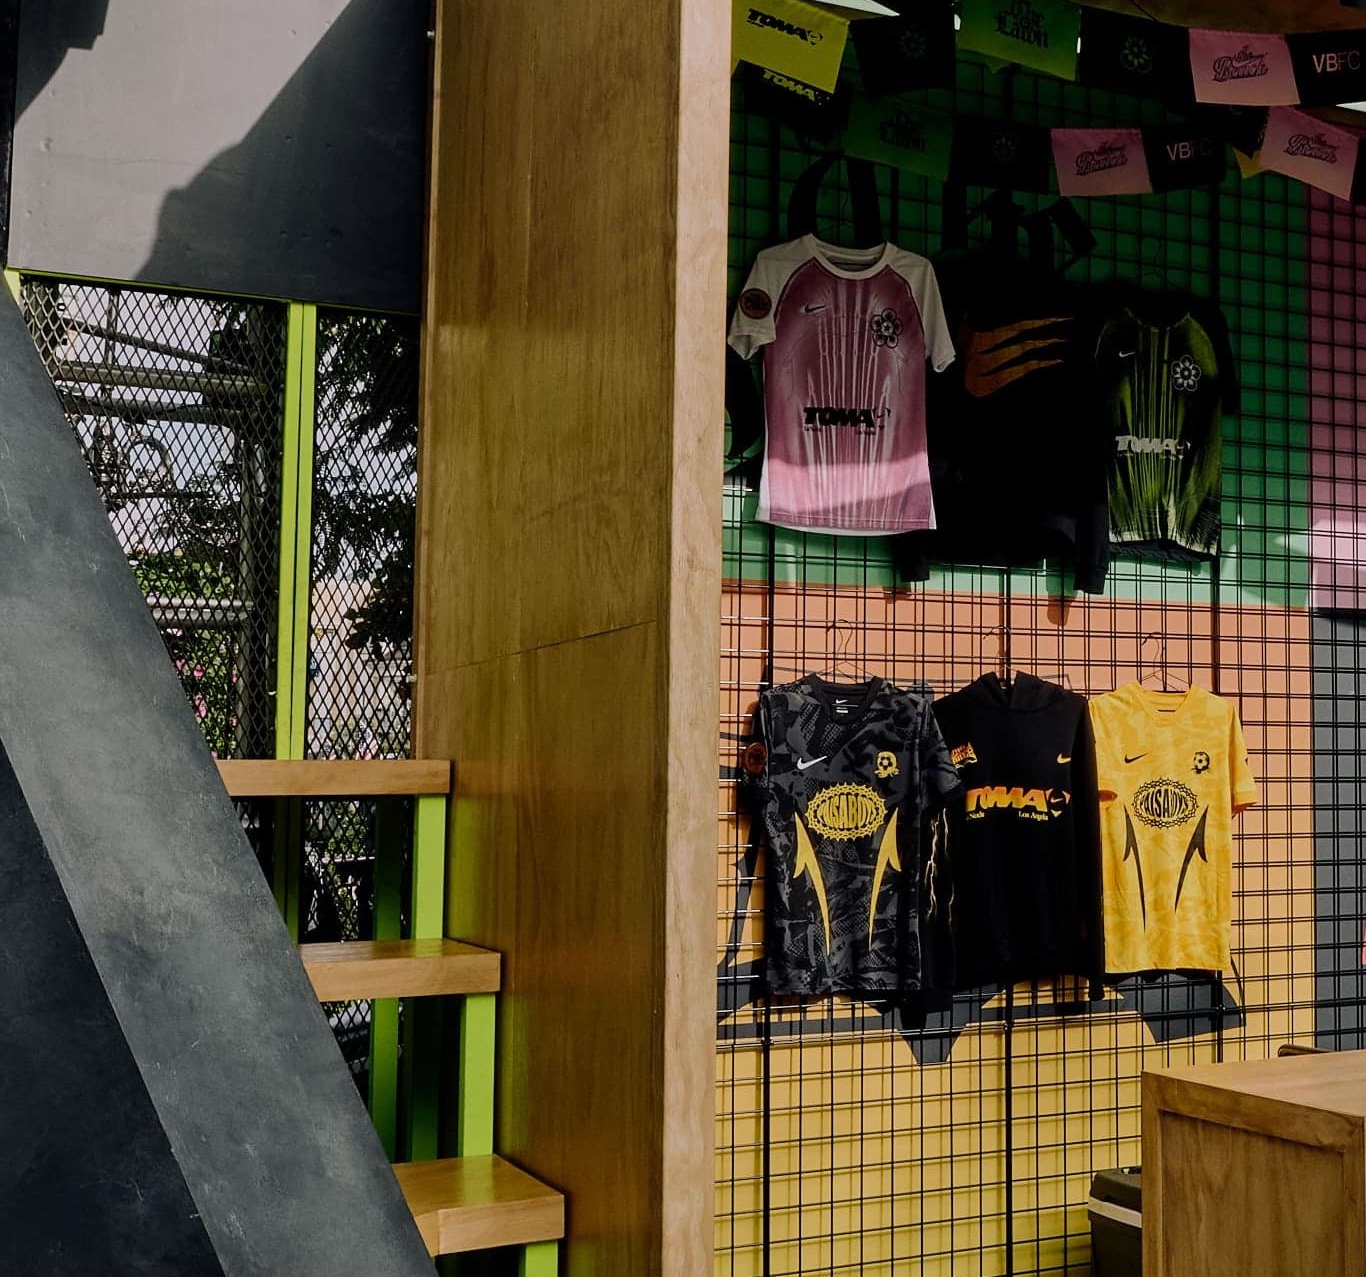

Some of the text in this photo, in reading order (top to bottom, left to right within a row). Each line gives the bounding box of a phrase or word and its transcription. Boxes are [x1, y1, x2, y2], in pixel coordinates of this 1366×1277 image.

[747, 8, 810, 42] TOMA
[1312, 49, 1362, 74] VBFC
[762, 68, 816, 101] TOMA
[803, 407, 875, 428] TOMA
[1114, 434, 1177, 455] TOMA
[965, 785, 1049, 813] TOMA
